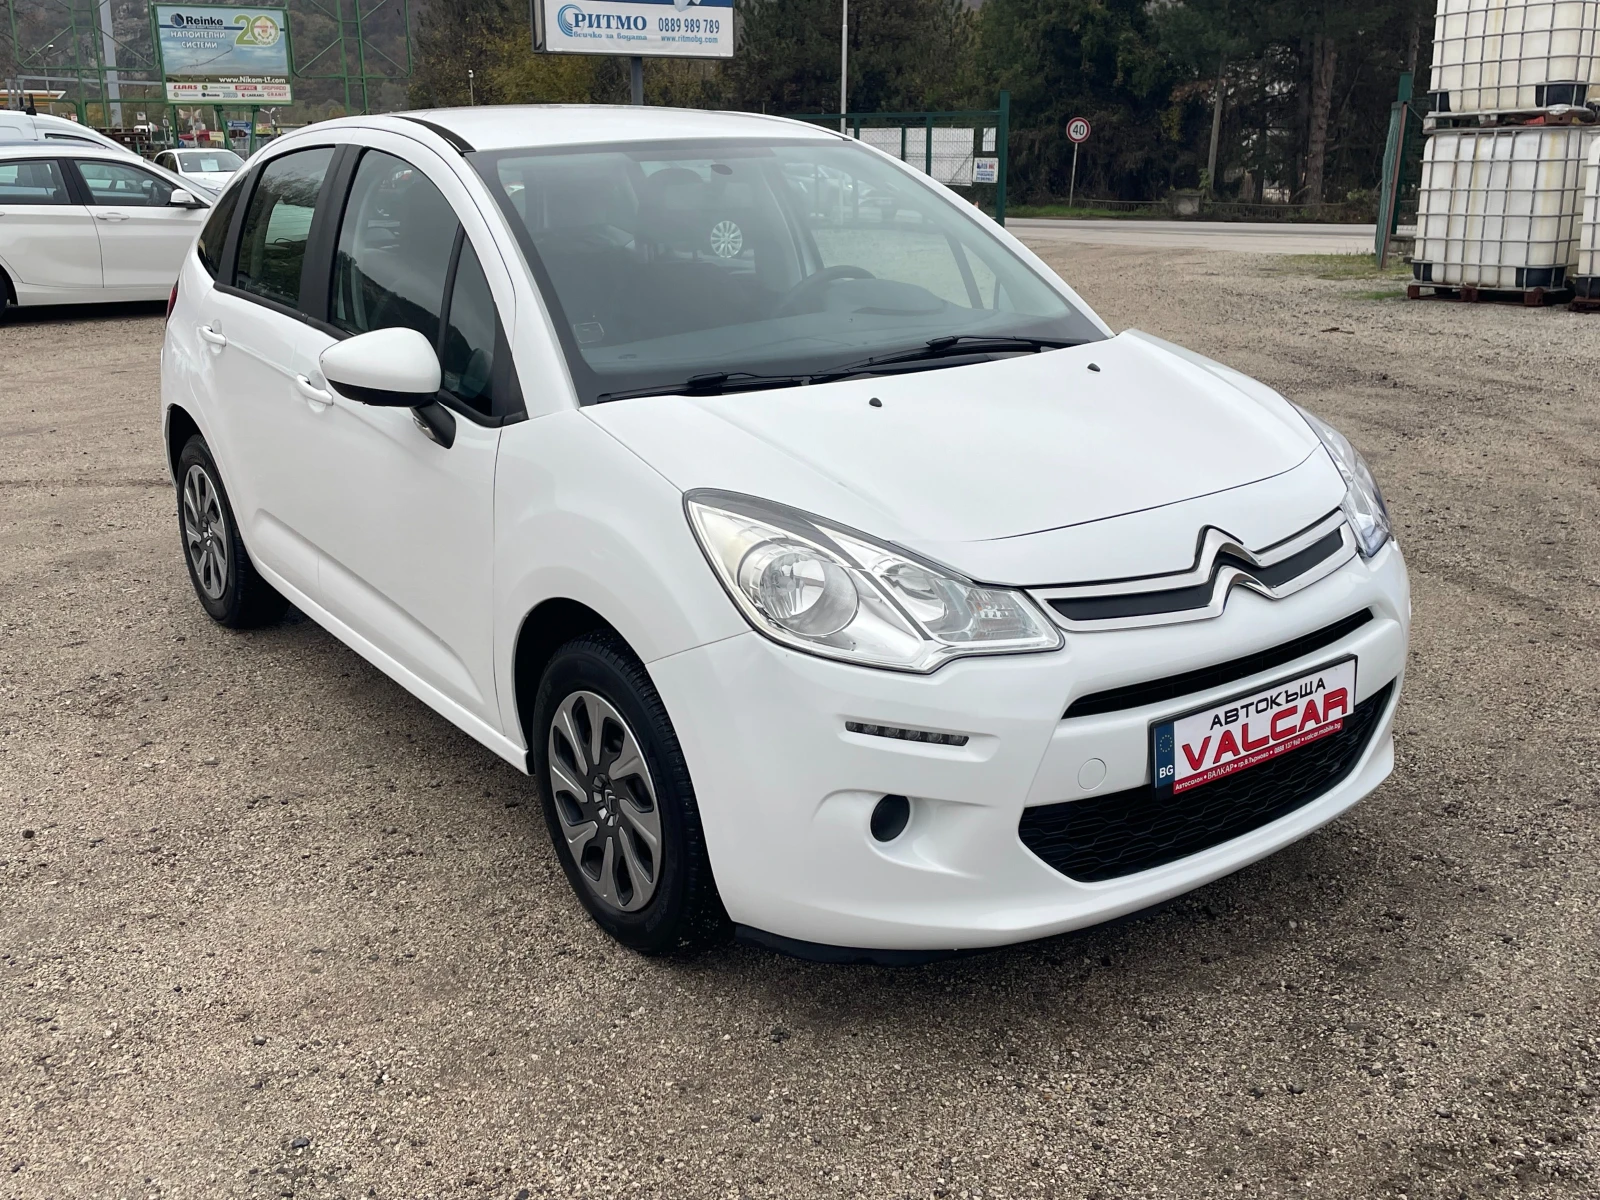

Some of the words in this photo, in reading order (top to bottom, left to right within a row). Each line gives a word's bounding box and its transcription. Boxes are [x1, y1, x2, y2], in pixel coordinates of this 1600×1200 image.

[185, 15, 224, 26] Reinke
[572, 12, 647, 31] РИТМО
[658, 17, 681, 32] 0889
[684, 18, 701, 33] 989
[703, 19, 720, 34] 789
[233, 14, 280, 46] 20
[573, 31, 602, 39] всичко
[617, 32, 648, 41] водата
[181, 40, 218, 49] СИСТЕМИ
[661, 35, 719, 45] www.ritmobg.com
[1073, 124, 1085, 136] 40
[1209, 677, 1326, 731] АВТОКЪЩА
[1181, 687, 1348, 771] VALCAR
[1175, 775, 1204, 791] Автосалон
[1207, 763, 1235, 780] ВАЛКАР
[1304, 722, 1341, 741] valcar.mobile.bg
[1159, 764, 1174, 779] BG
